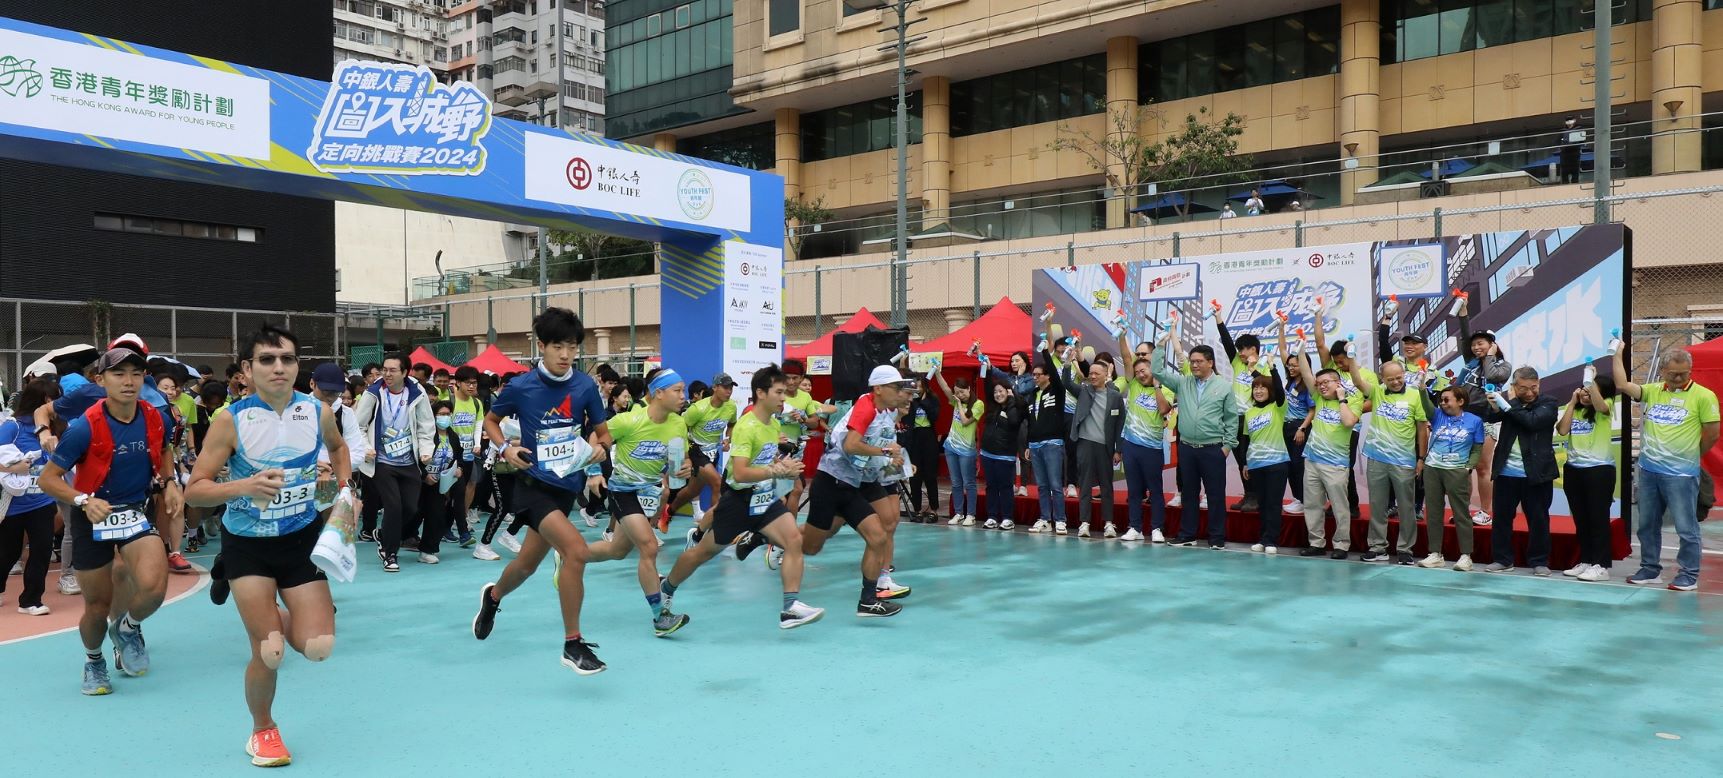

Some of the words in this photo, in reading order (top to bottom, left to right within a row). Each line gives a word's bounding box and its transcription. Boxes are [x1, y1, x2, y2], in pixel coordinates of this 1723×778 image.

[50, 67, 234, 117] 香港青年獎勵計劃
[342, 71, 414, 94] 中銀人壽
[51, 95, 69, 104] THE
[71, 98, 95, 109] HONG
[97, 102, 122, 112] KONG
[124, 106, 157, 118] AWARD
[159, 112, 175, 121] FOR
[178, 115, 204, 126] YOUNG
[206, 120, 236, 131] PEOPLE
[598, 182, 617, 193] BOC
[620, 186, 641, 198] LIFE
[130, 440, 145, 452] T8
